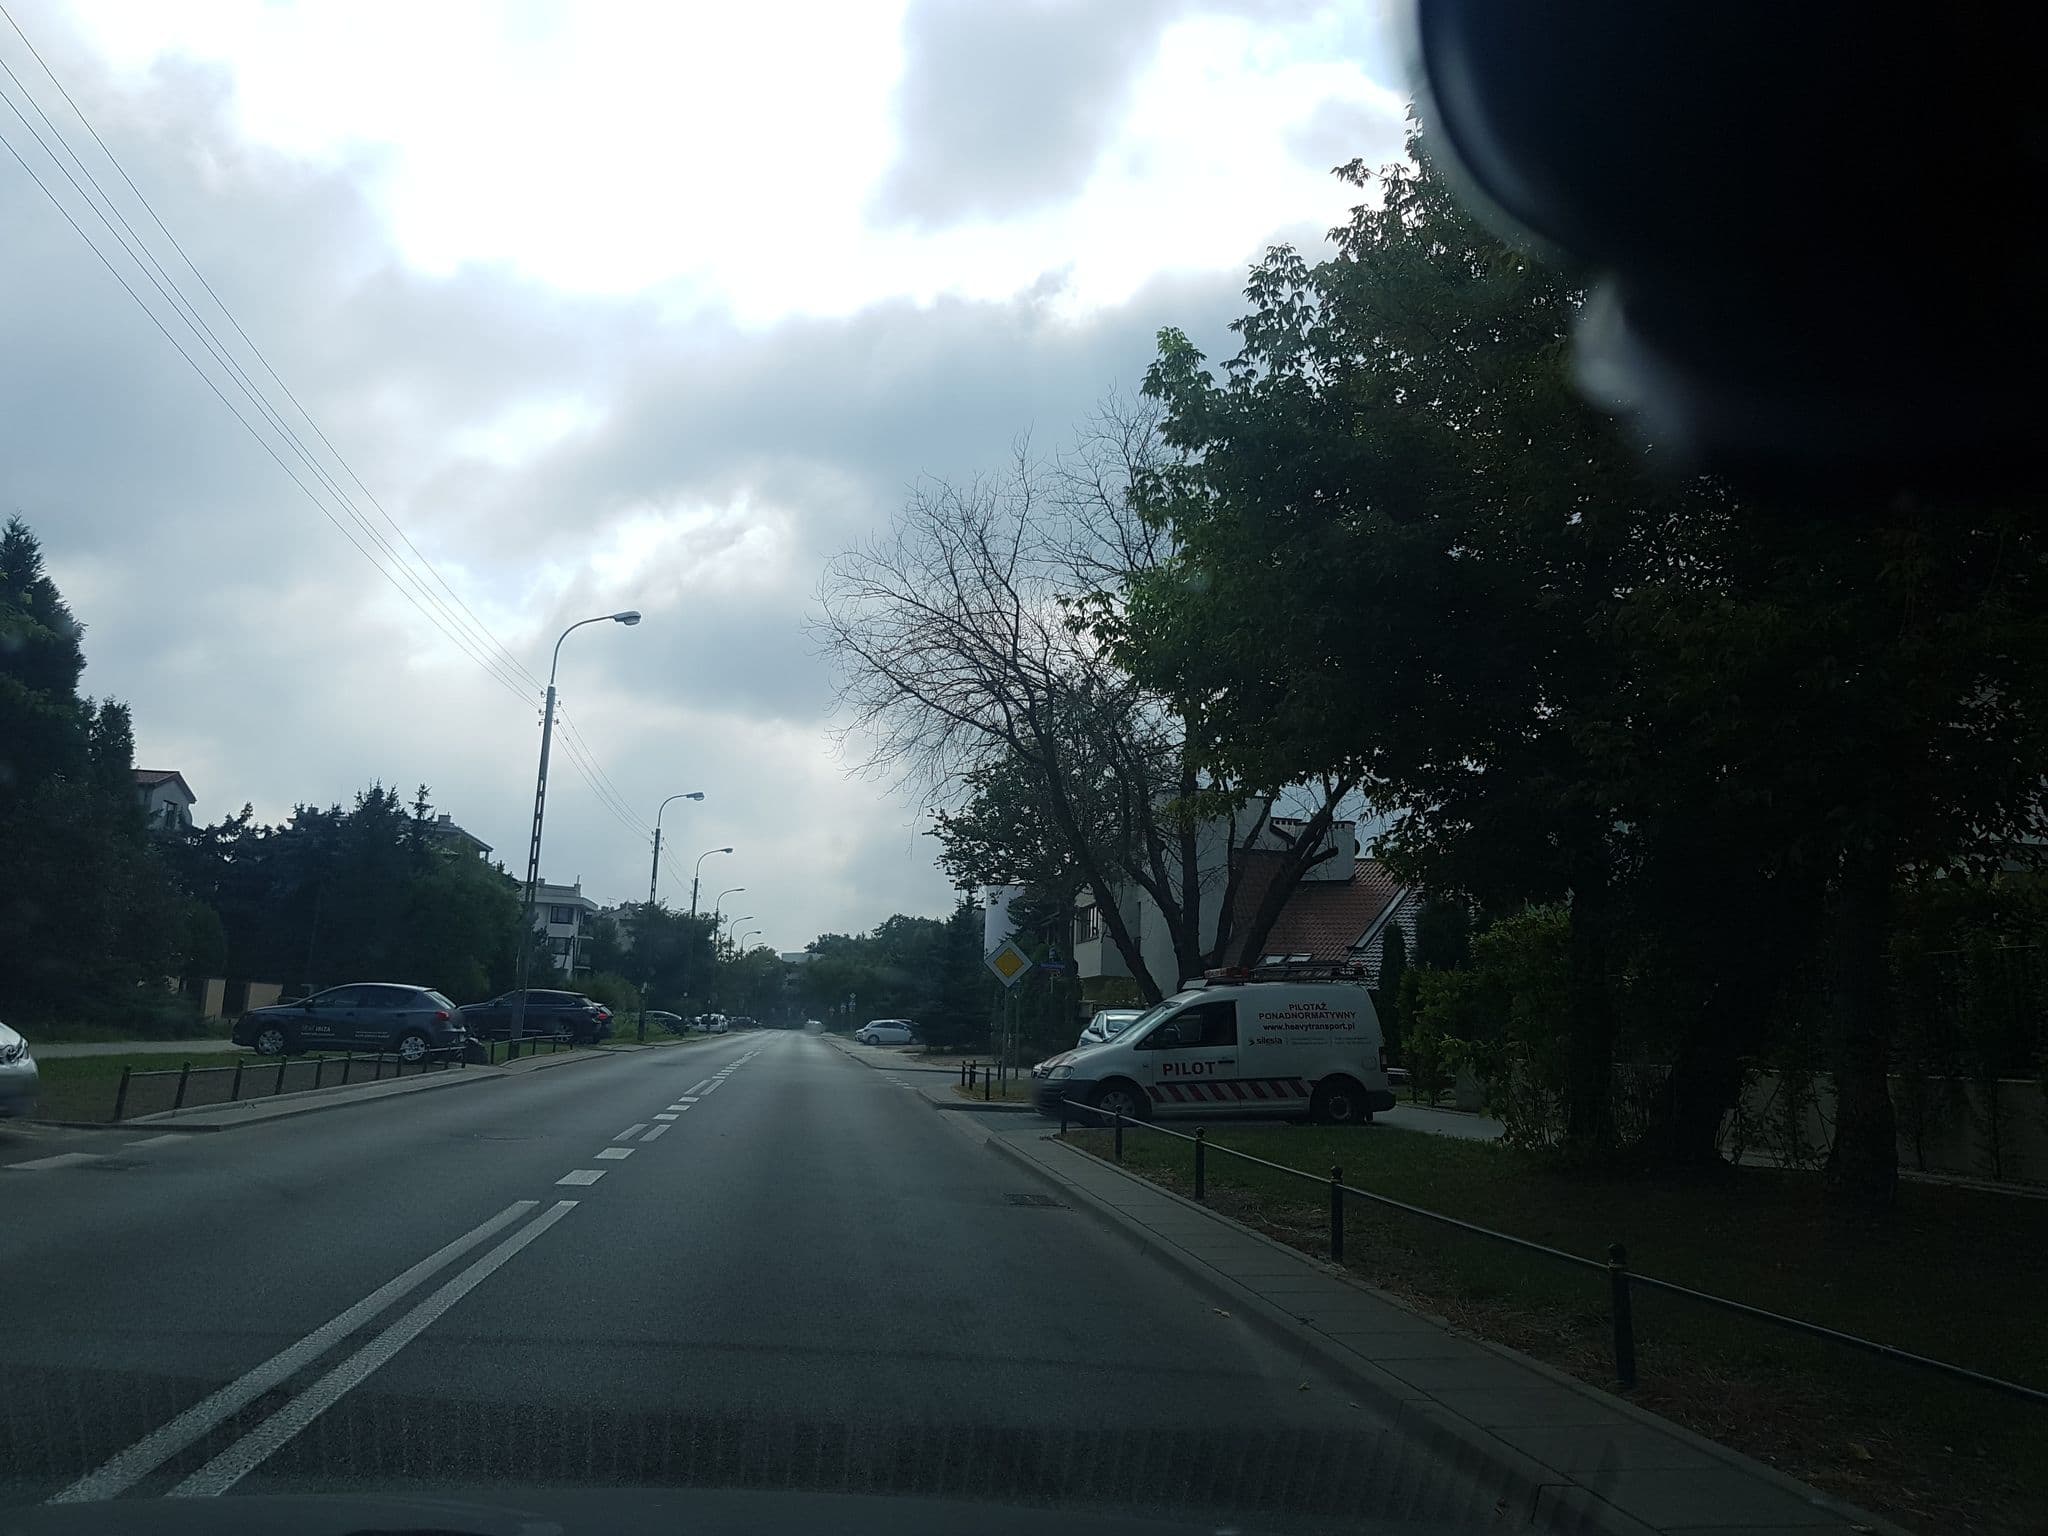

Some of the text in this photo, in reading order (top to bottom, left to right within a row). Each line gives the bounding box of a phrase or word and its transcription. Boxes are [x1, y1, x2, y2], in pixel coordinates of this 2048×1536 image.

[1258, 1011, 1356, 1020] PONADNORMATYWNY
[1263, 1022, 1355, 1032] www.heavytransport.pl
[1162, 1061, 1216, 1076] PILOT
